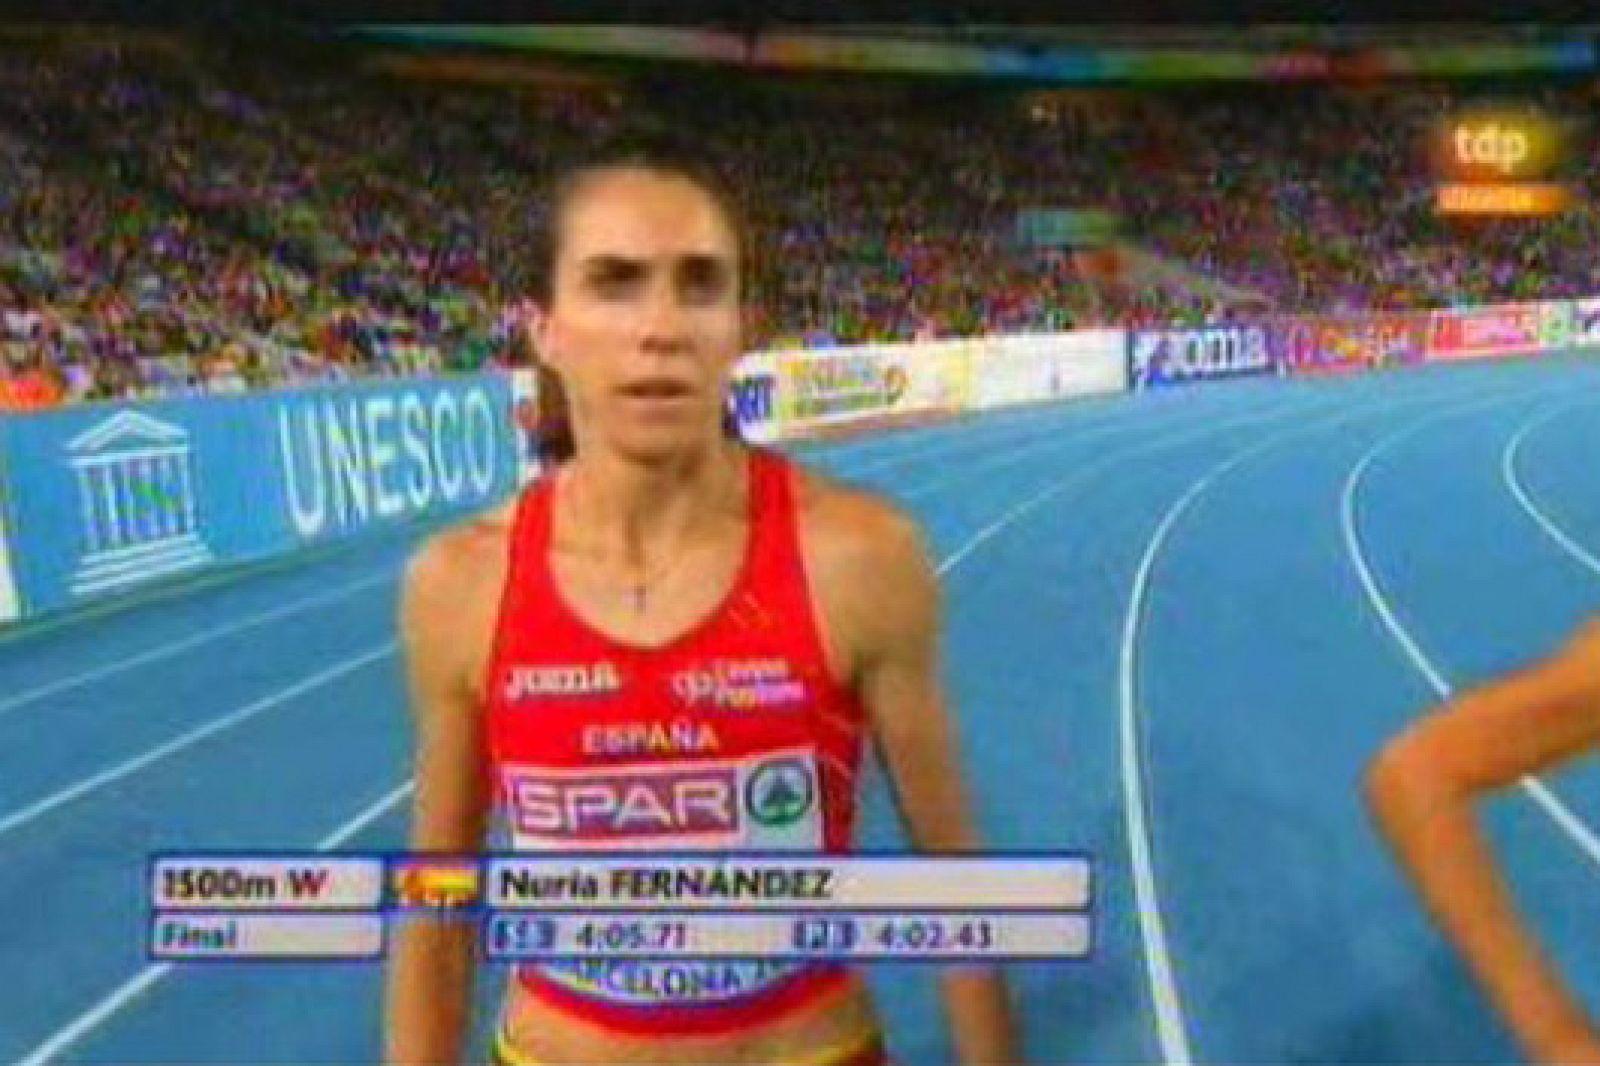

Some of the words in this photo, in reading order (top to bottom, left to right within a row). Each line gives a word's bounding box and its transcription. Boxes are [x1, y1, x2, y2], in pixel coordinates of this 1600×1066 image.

[280, 387, 497, 537] UNESCO
[580, 718, 721, 755] ESPAÑA
[514, 776, 734, 836] SPAR
